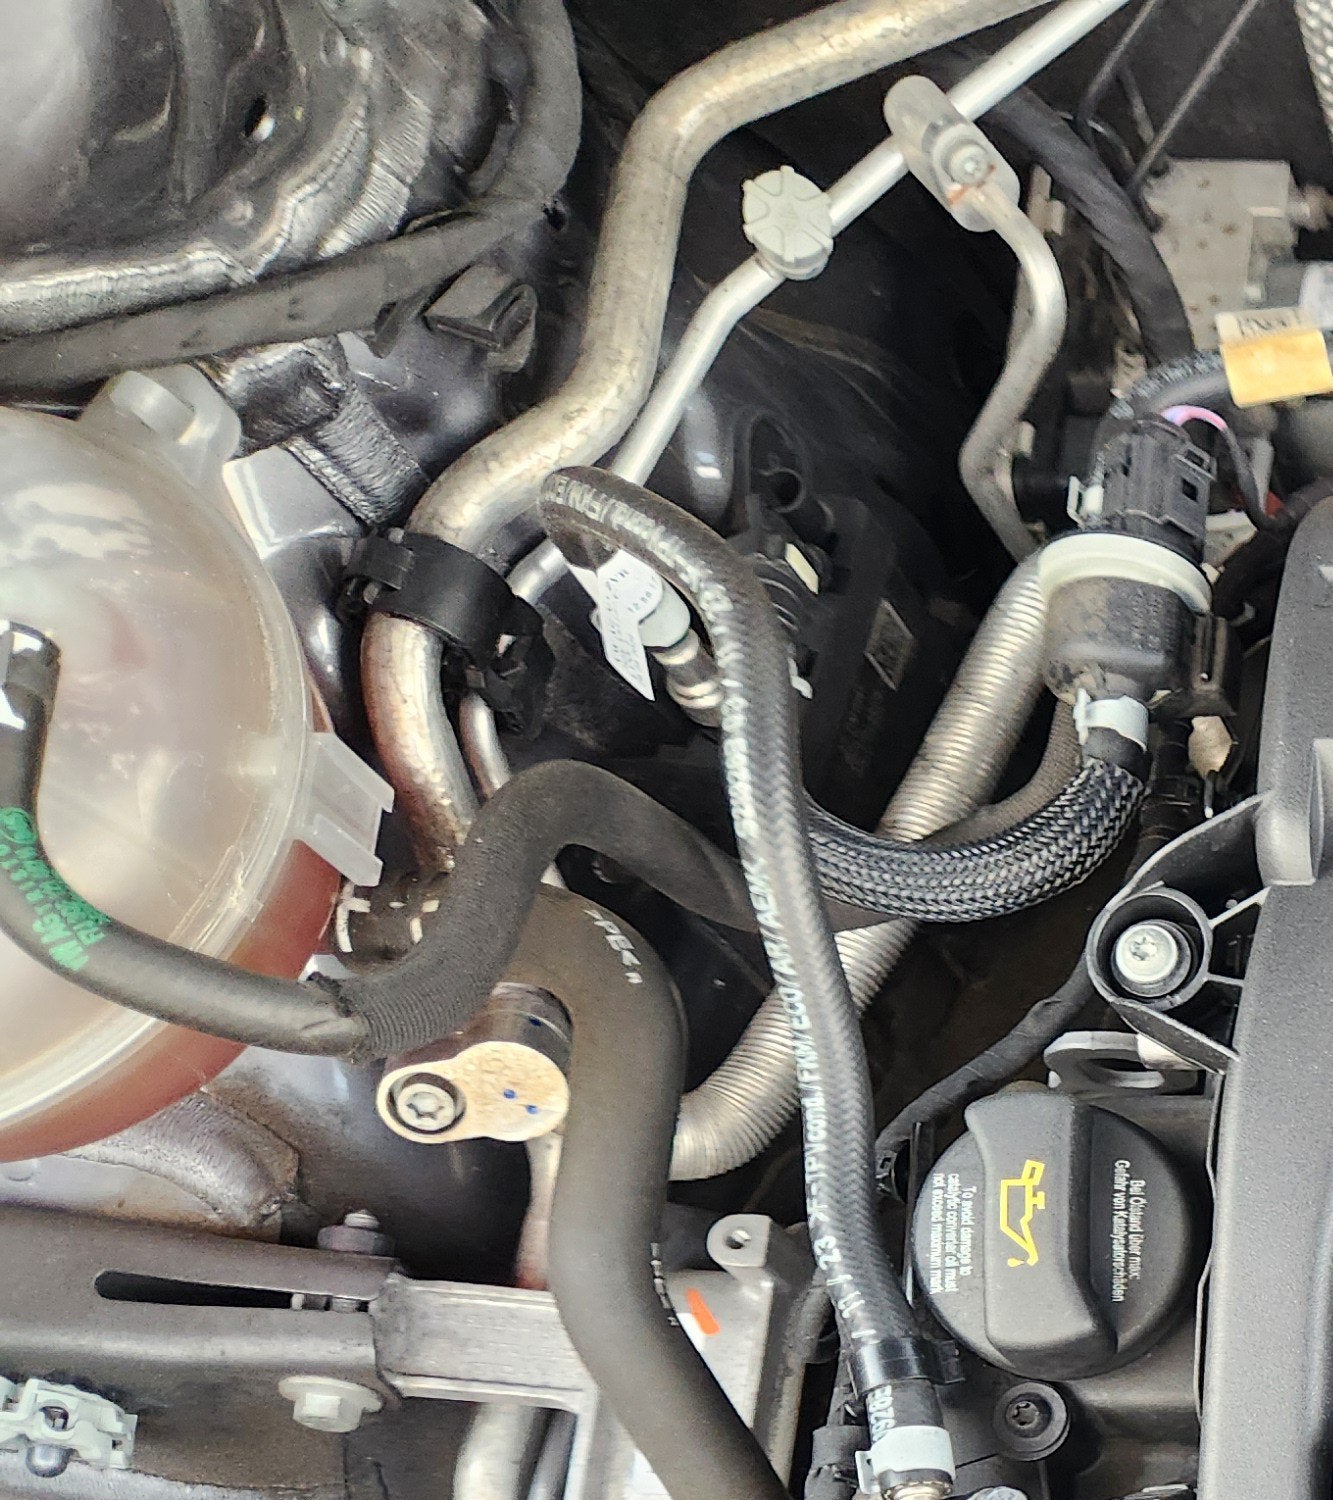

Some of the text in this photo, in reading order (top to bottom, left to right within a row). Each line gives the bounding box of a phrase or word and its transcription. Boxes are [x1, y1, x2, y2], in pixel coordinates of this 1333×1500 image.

[1113, 1160, 1131, 1191] Gefahr
[961, 1186, 977, 1199] To
[1112, 1191, 1126, 1210] von
